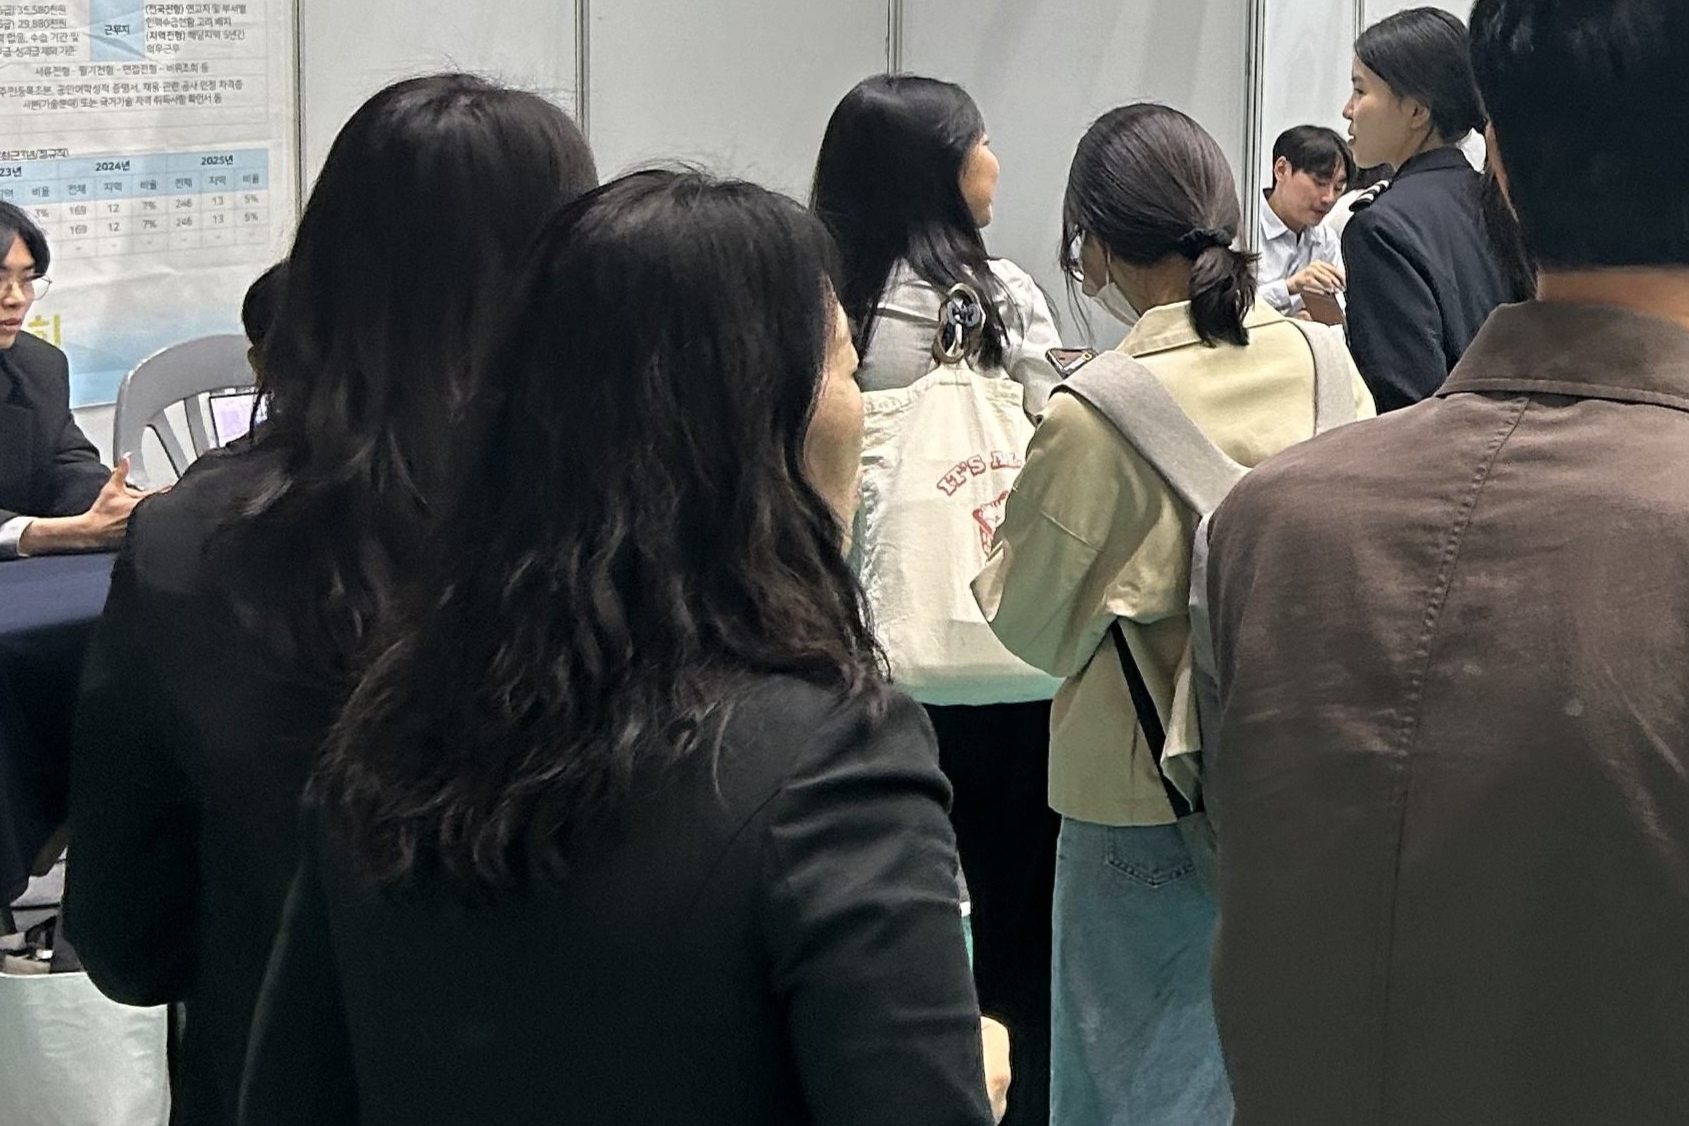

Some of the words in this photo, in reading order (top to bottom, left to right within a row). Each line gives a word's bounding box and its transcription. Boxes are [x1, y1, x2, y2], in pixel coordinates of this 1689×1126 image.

[104, 24, 130, 35] 근무지
[95, 160, 130, 172] 2024년
[201, 155, 234, 166] 2025년
[107, 203, 120, 213] 12
[108, 222, 120, 232] 12
[212, 214, 224, 224] 13
